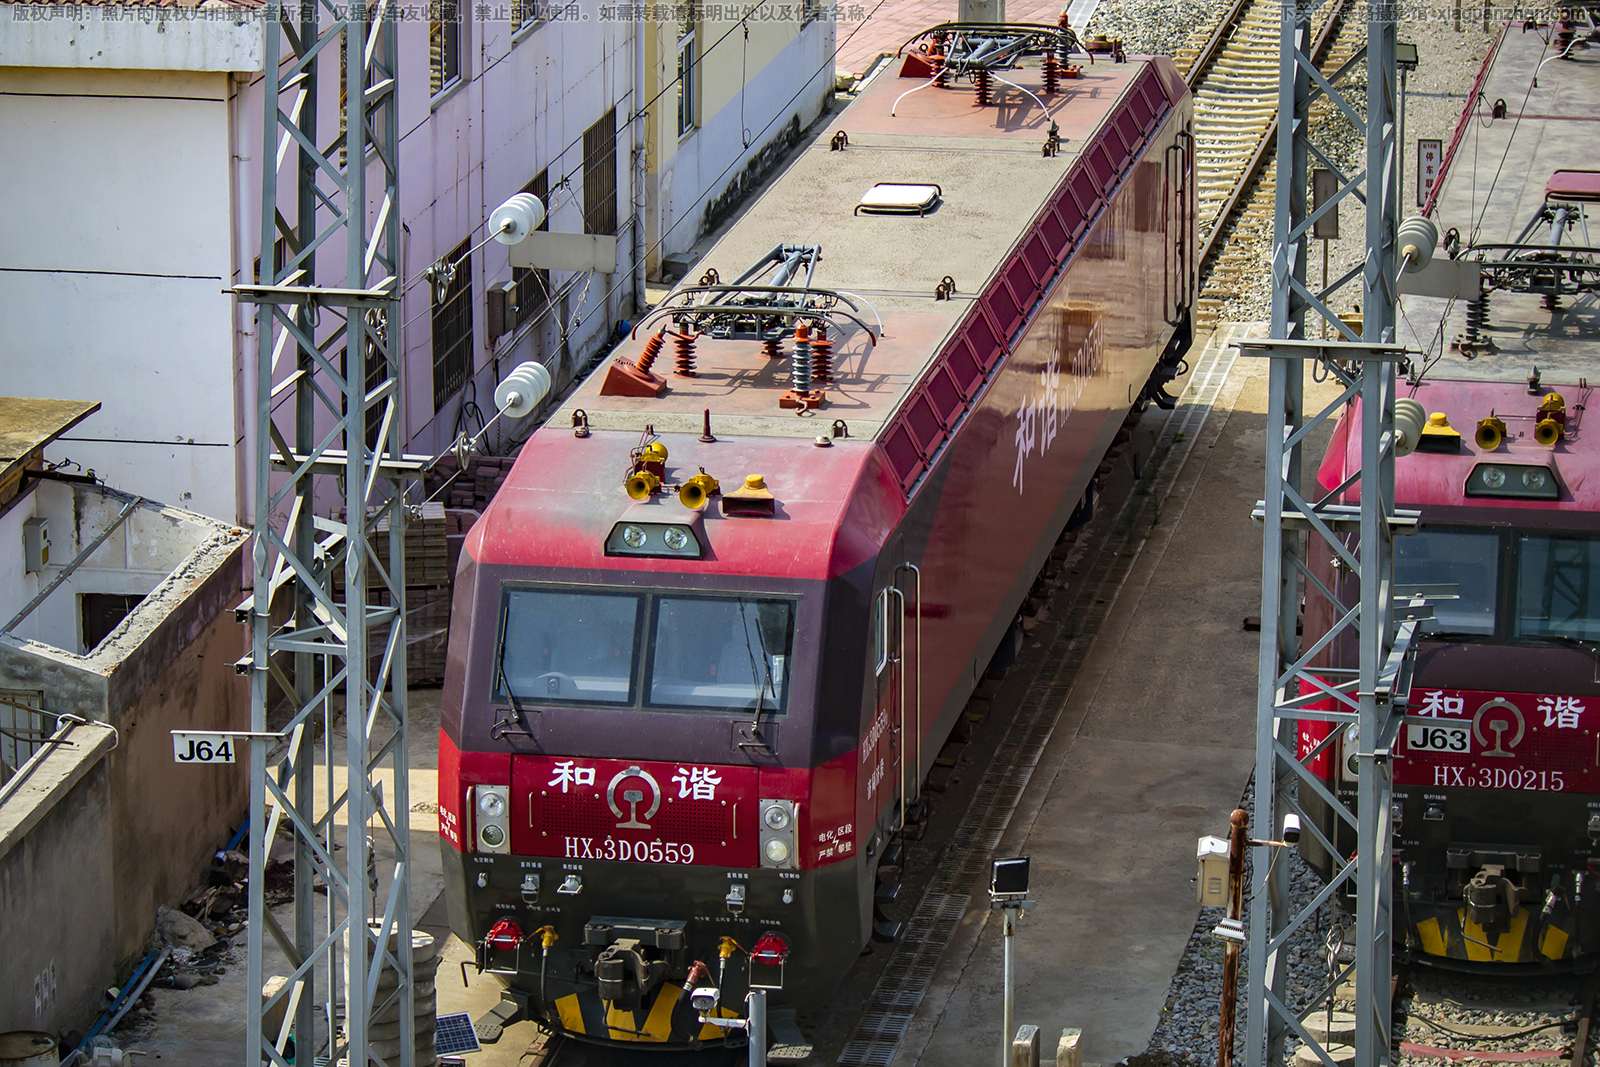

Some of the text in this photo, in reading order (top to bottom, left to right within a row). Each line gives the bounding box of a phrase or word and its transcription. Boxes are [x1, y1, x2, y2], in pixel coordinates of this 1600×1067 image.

[1537, 696, 1586, 729] 谐
[178, 740, 232, 761] J64
[1411, 727, 1467, 751] J63
[1434, 766, 1564, 791] HXD3D0215
[565, 836, 695, 865] HXD3D0559
